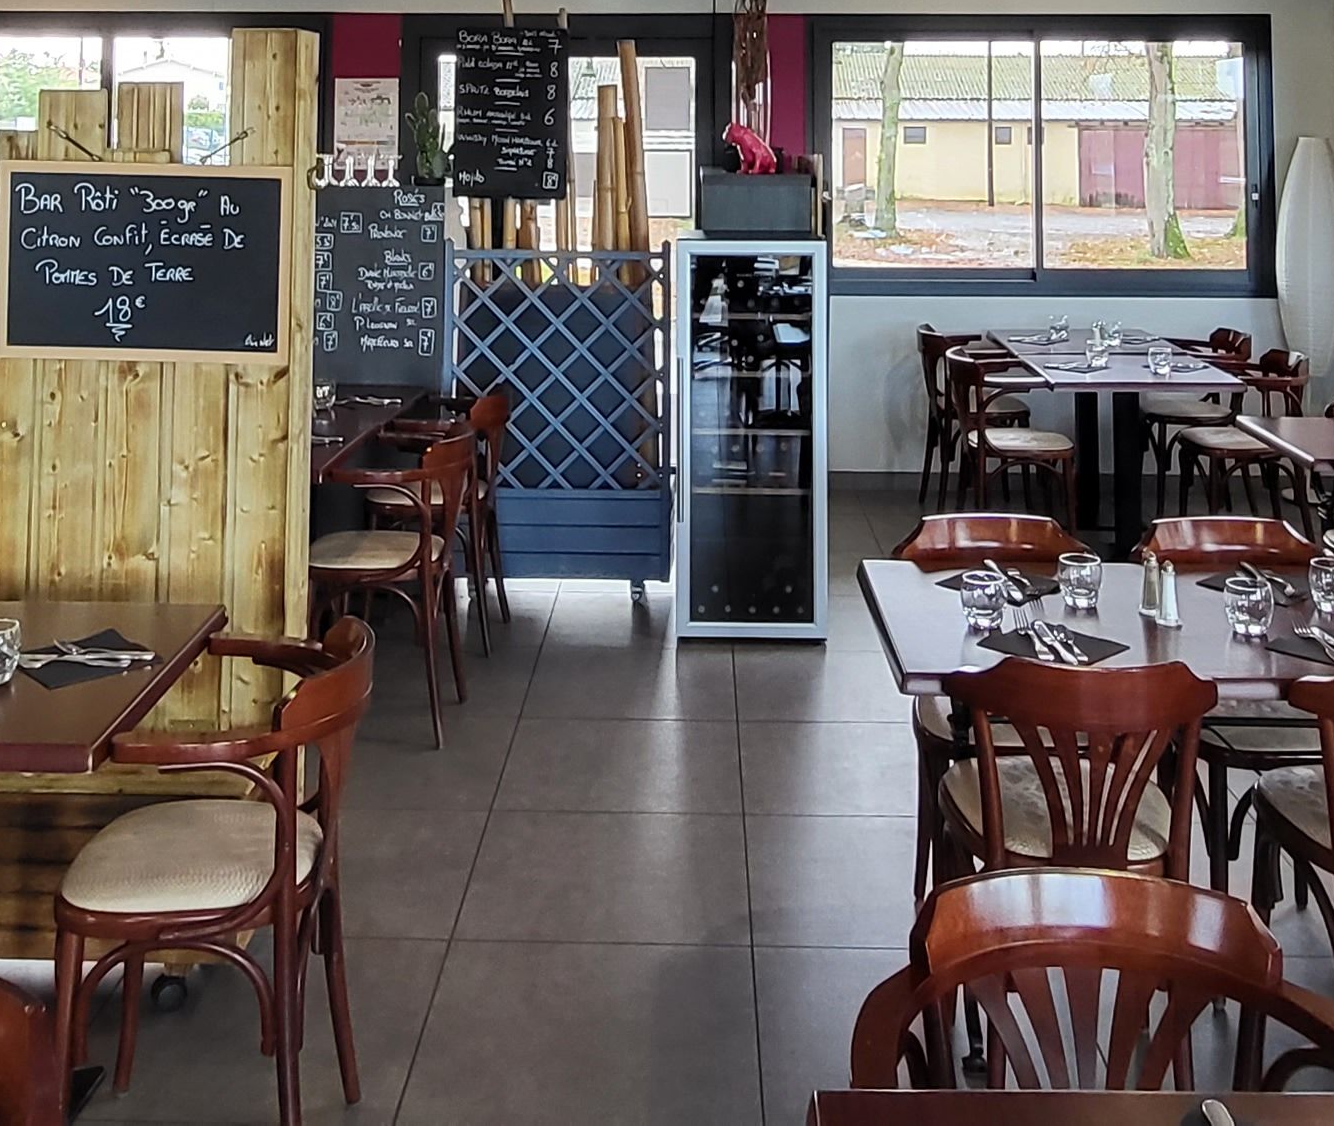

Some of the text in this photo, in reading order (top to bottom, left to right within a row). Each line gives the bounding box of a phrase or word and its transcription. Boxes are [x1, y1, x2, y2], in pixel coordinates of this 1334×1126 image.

[548, 39, 563, 54] 7
[550, 62, 559, 77] 8
[547, 84, 556, 100] 8
[544, 108, 555, 125] 6
